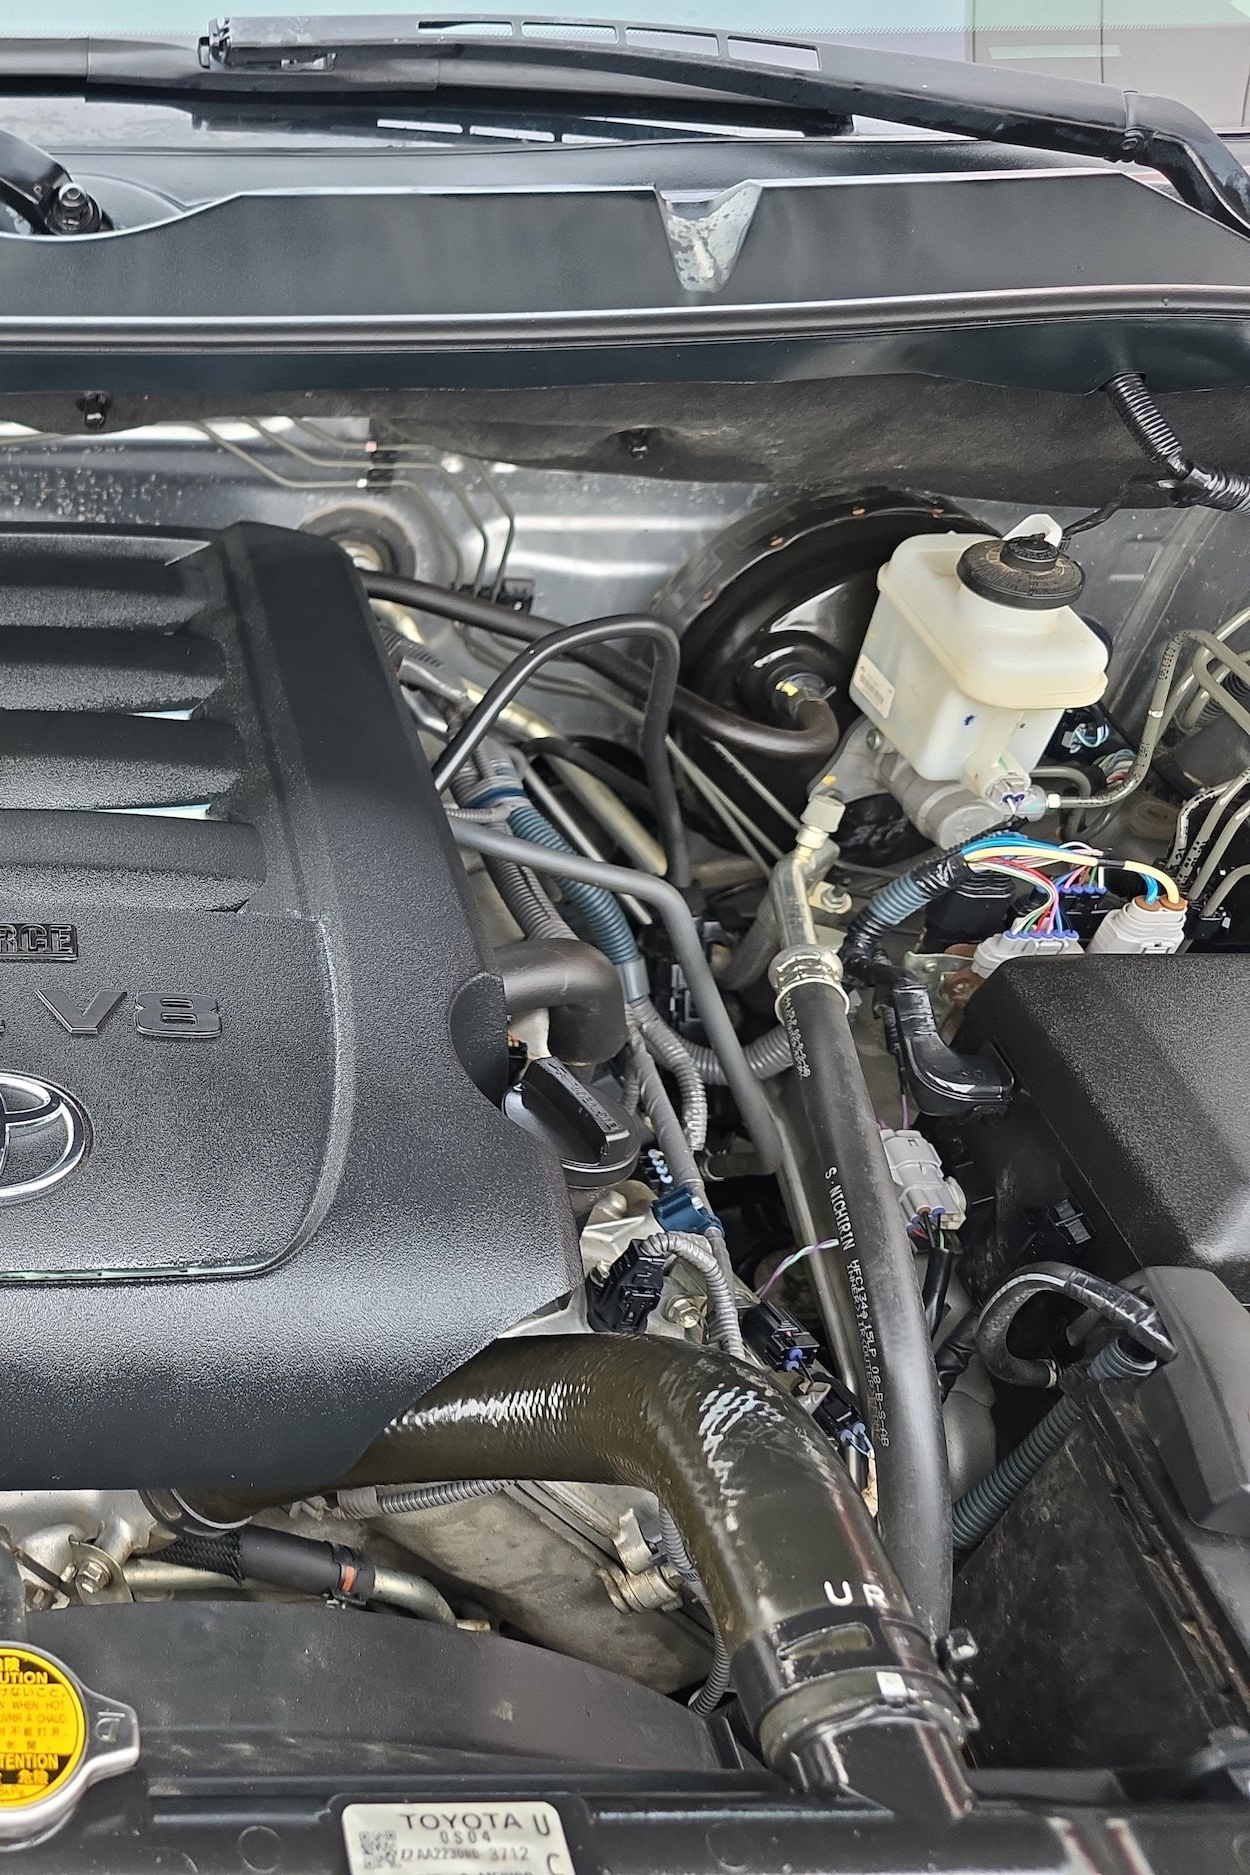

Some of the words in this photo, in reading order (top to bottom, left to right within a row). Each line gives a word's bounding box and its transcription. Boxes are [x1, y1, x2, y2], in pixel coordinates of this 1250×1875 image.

[35, 990, 222, 1039] V8
[13, 1700, 38, 1709] WHEN
[46, 1700, 64, 1709] HOT
[401, 1812, 522, 1830] TOYOTA
[532, 1814, 550, 1837] U
